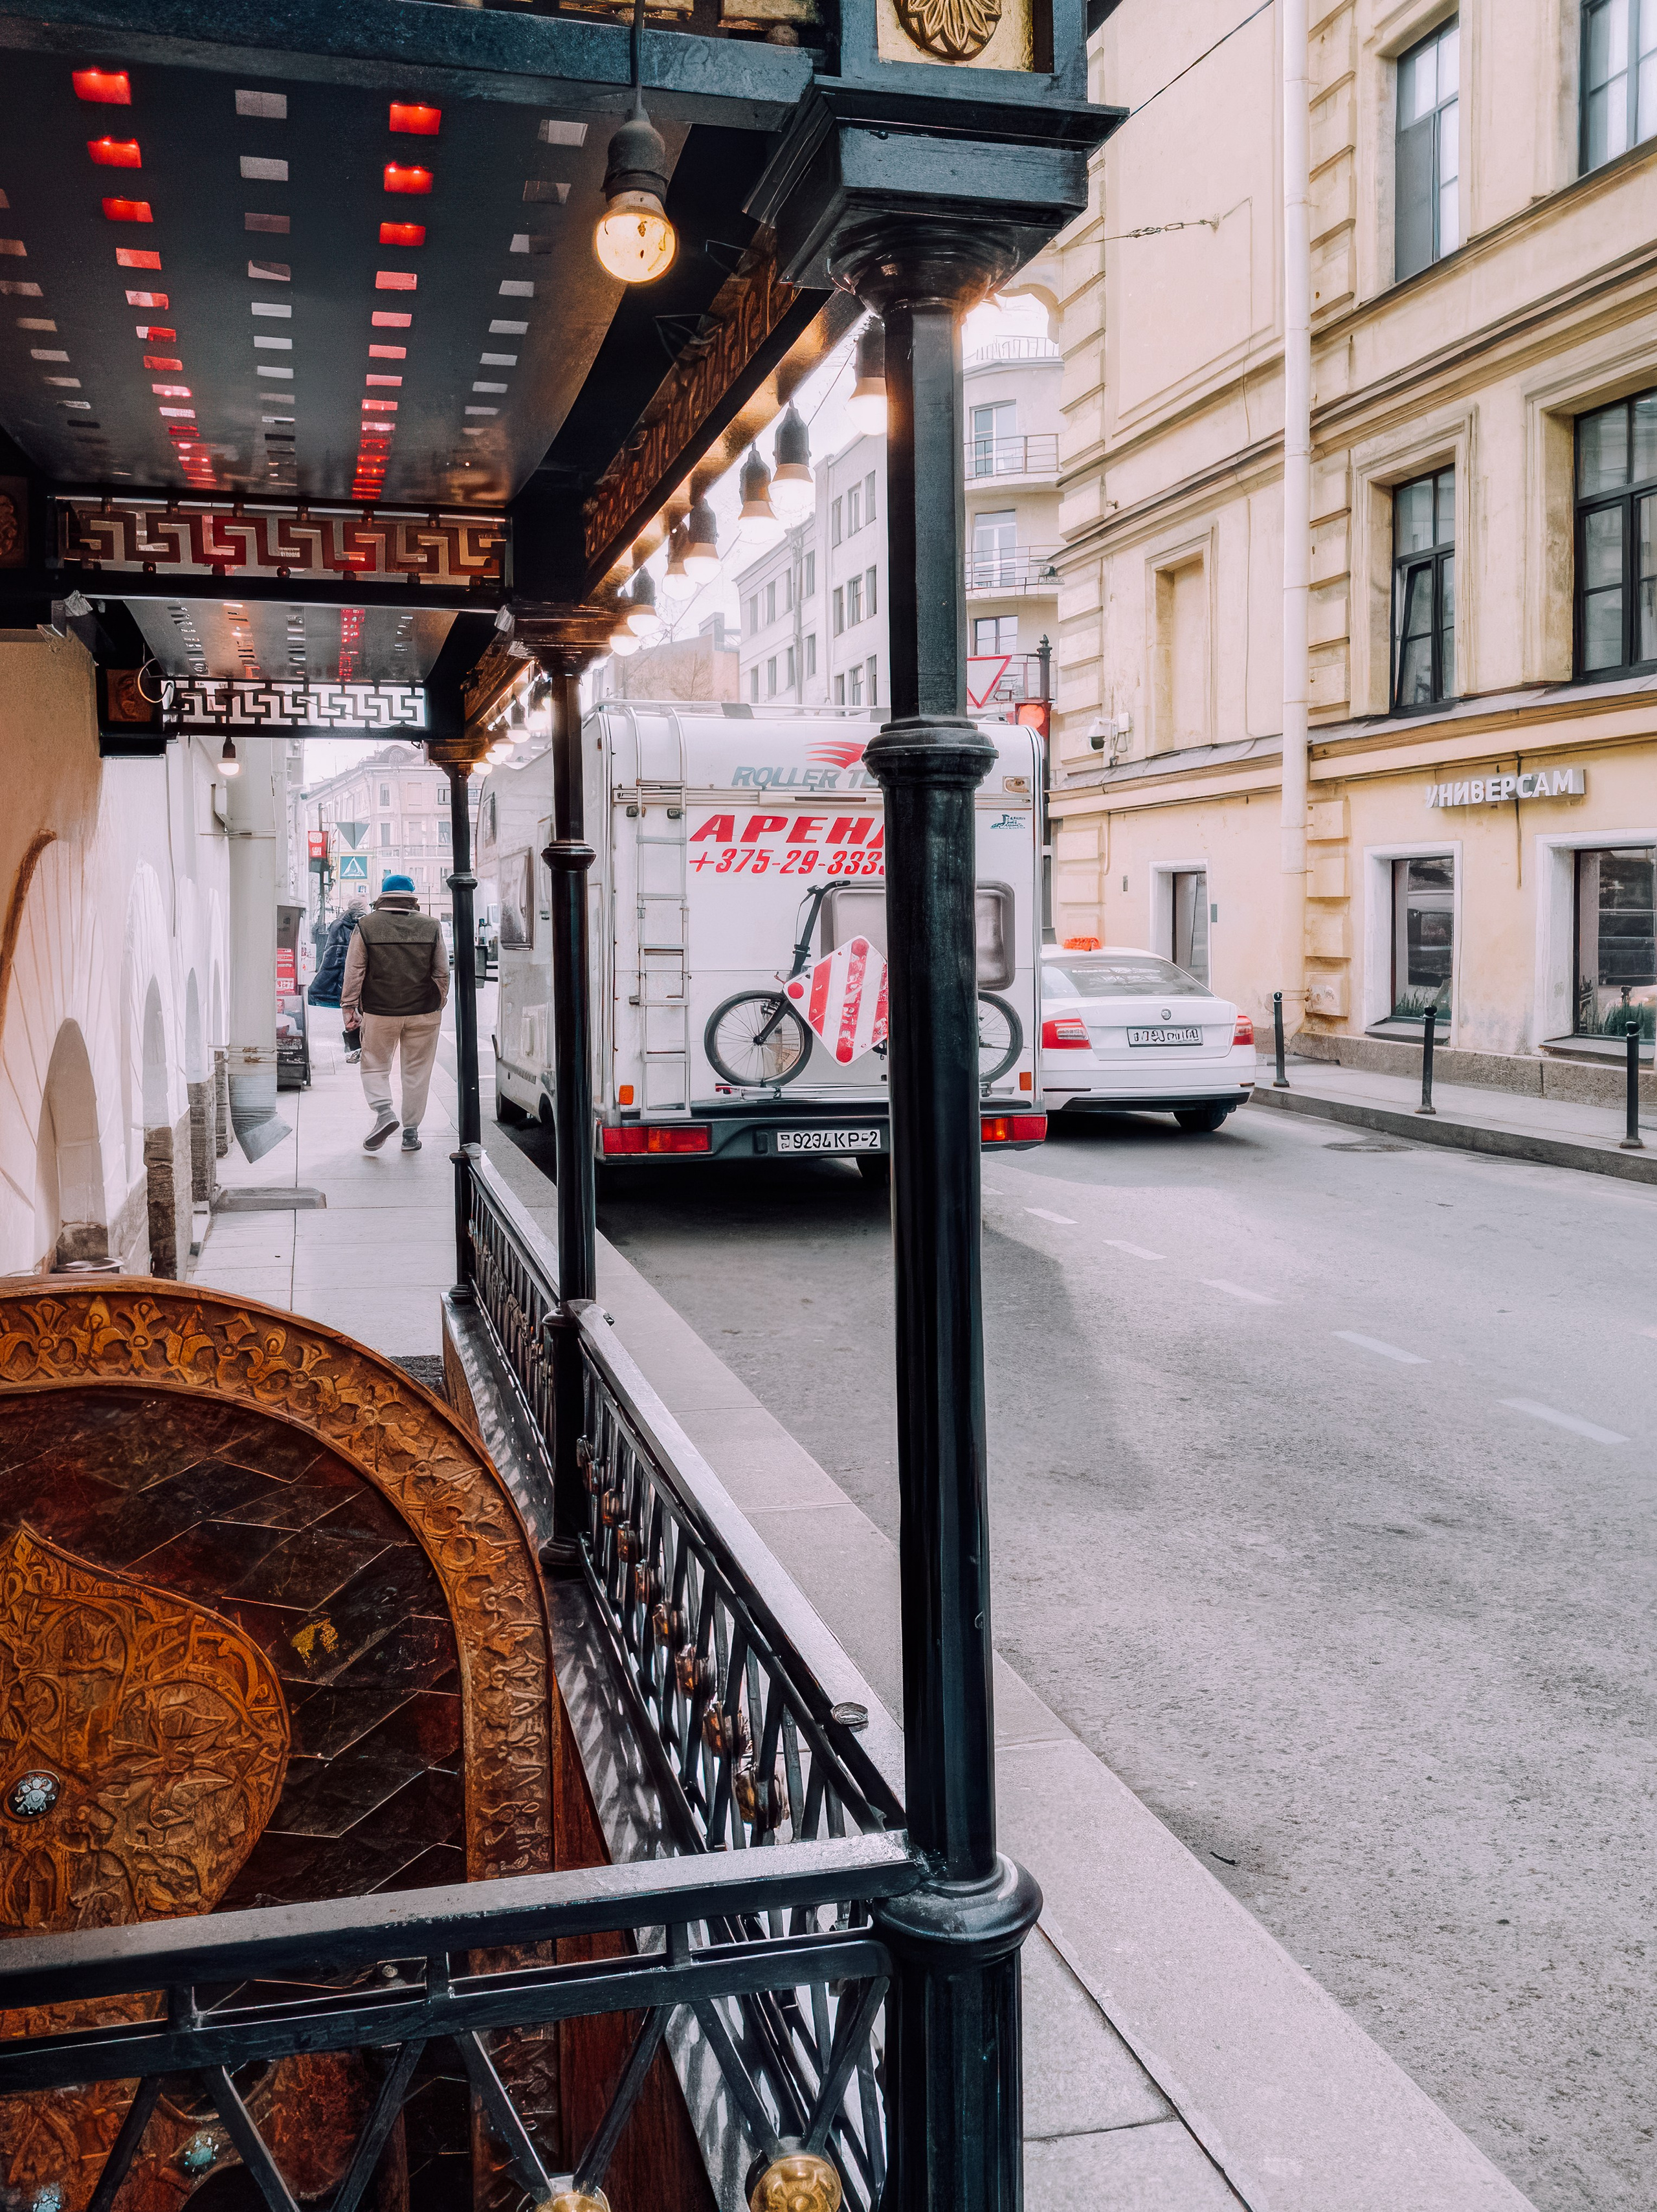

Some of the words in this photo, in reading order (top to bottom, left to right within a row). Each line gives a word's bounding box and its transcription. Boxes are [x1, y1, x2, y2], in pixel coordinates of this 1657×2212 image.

[731, 766, 841, 788] ROLLER
[1425, 768, 1574, 808] УНИВЕРСАМ
[689, 848, 884, 875] +375-29-333
